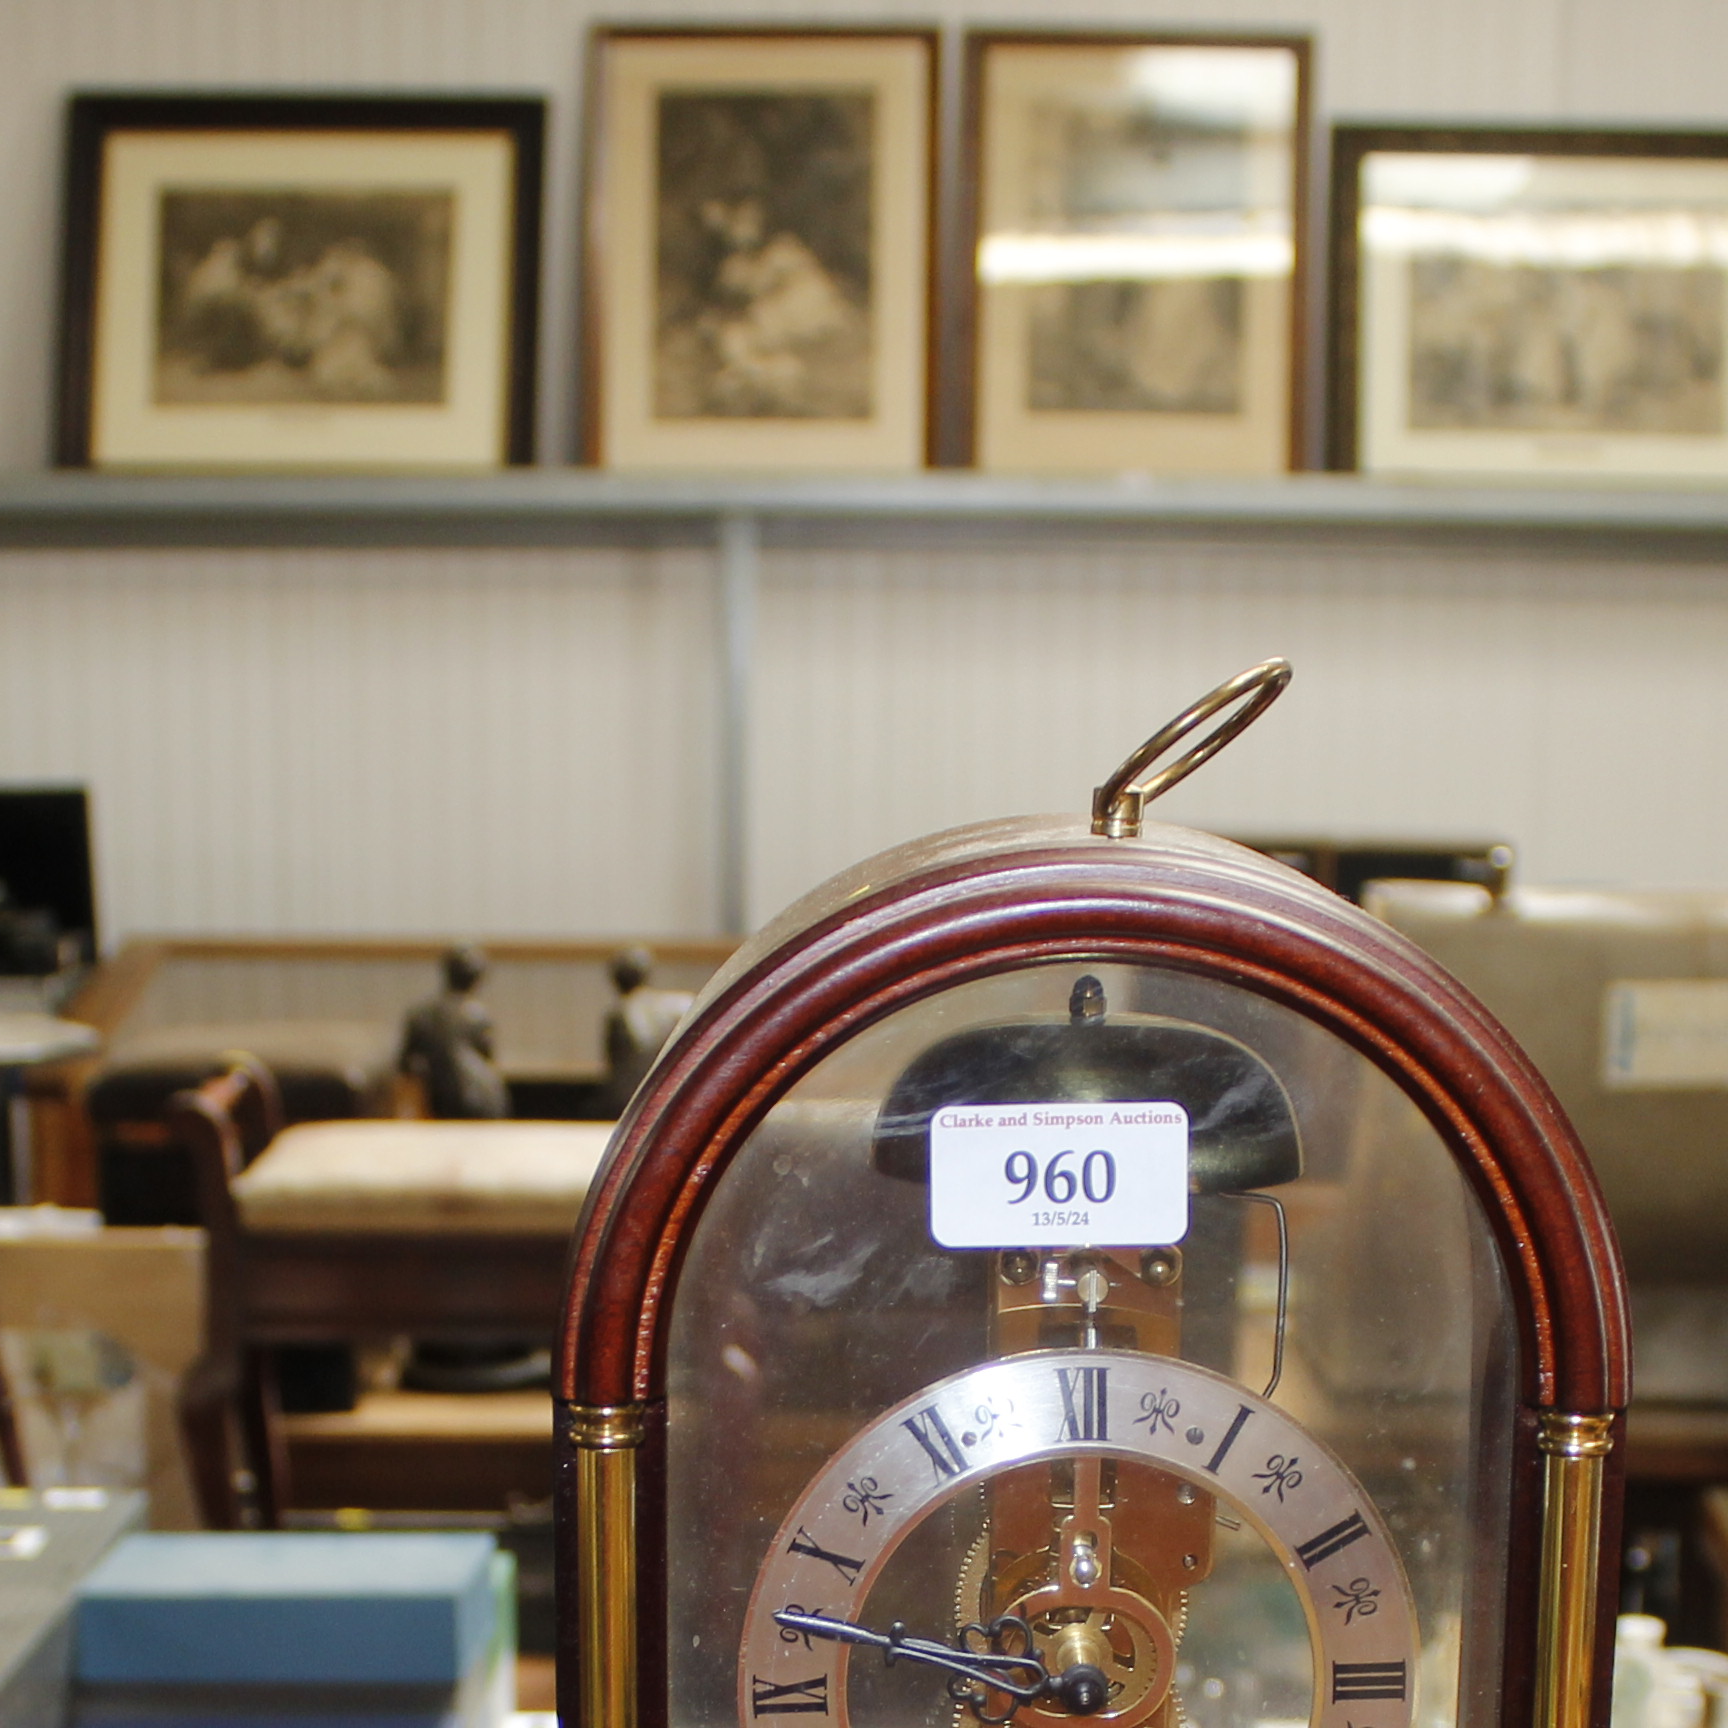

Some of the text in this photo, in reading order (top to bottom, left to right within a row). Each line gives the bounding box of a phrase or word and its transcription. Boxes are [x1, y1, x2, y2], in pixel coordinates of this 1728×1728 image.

[939, 1110, 1182, 1129] Clarke and Simpson Auctions
[1004, 1149, 1116, 1204] 960
[1032, 1211, 1090, 1226] 13/5/24
[1053, 1366, 1112, 1443] XII
[900, 1402, 973, 1488] XI
[1203, 1403, 1256, 1476] I
[787, 1525, 866, 1587] X
[1294, 1508, 1372, 1573] II
[752, 1672, 829, 1719] IX
[1331, 1658, 1407, 1706] III
